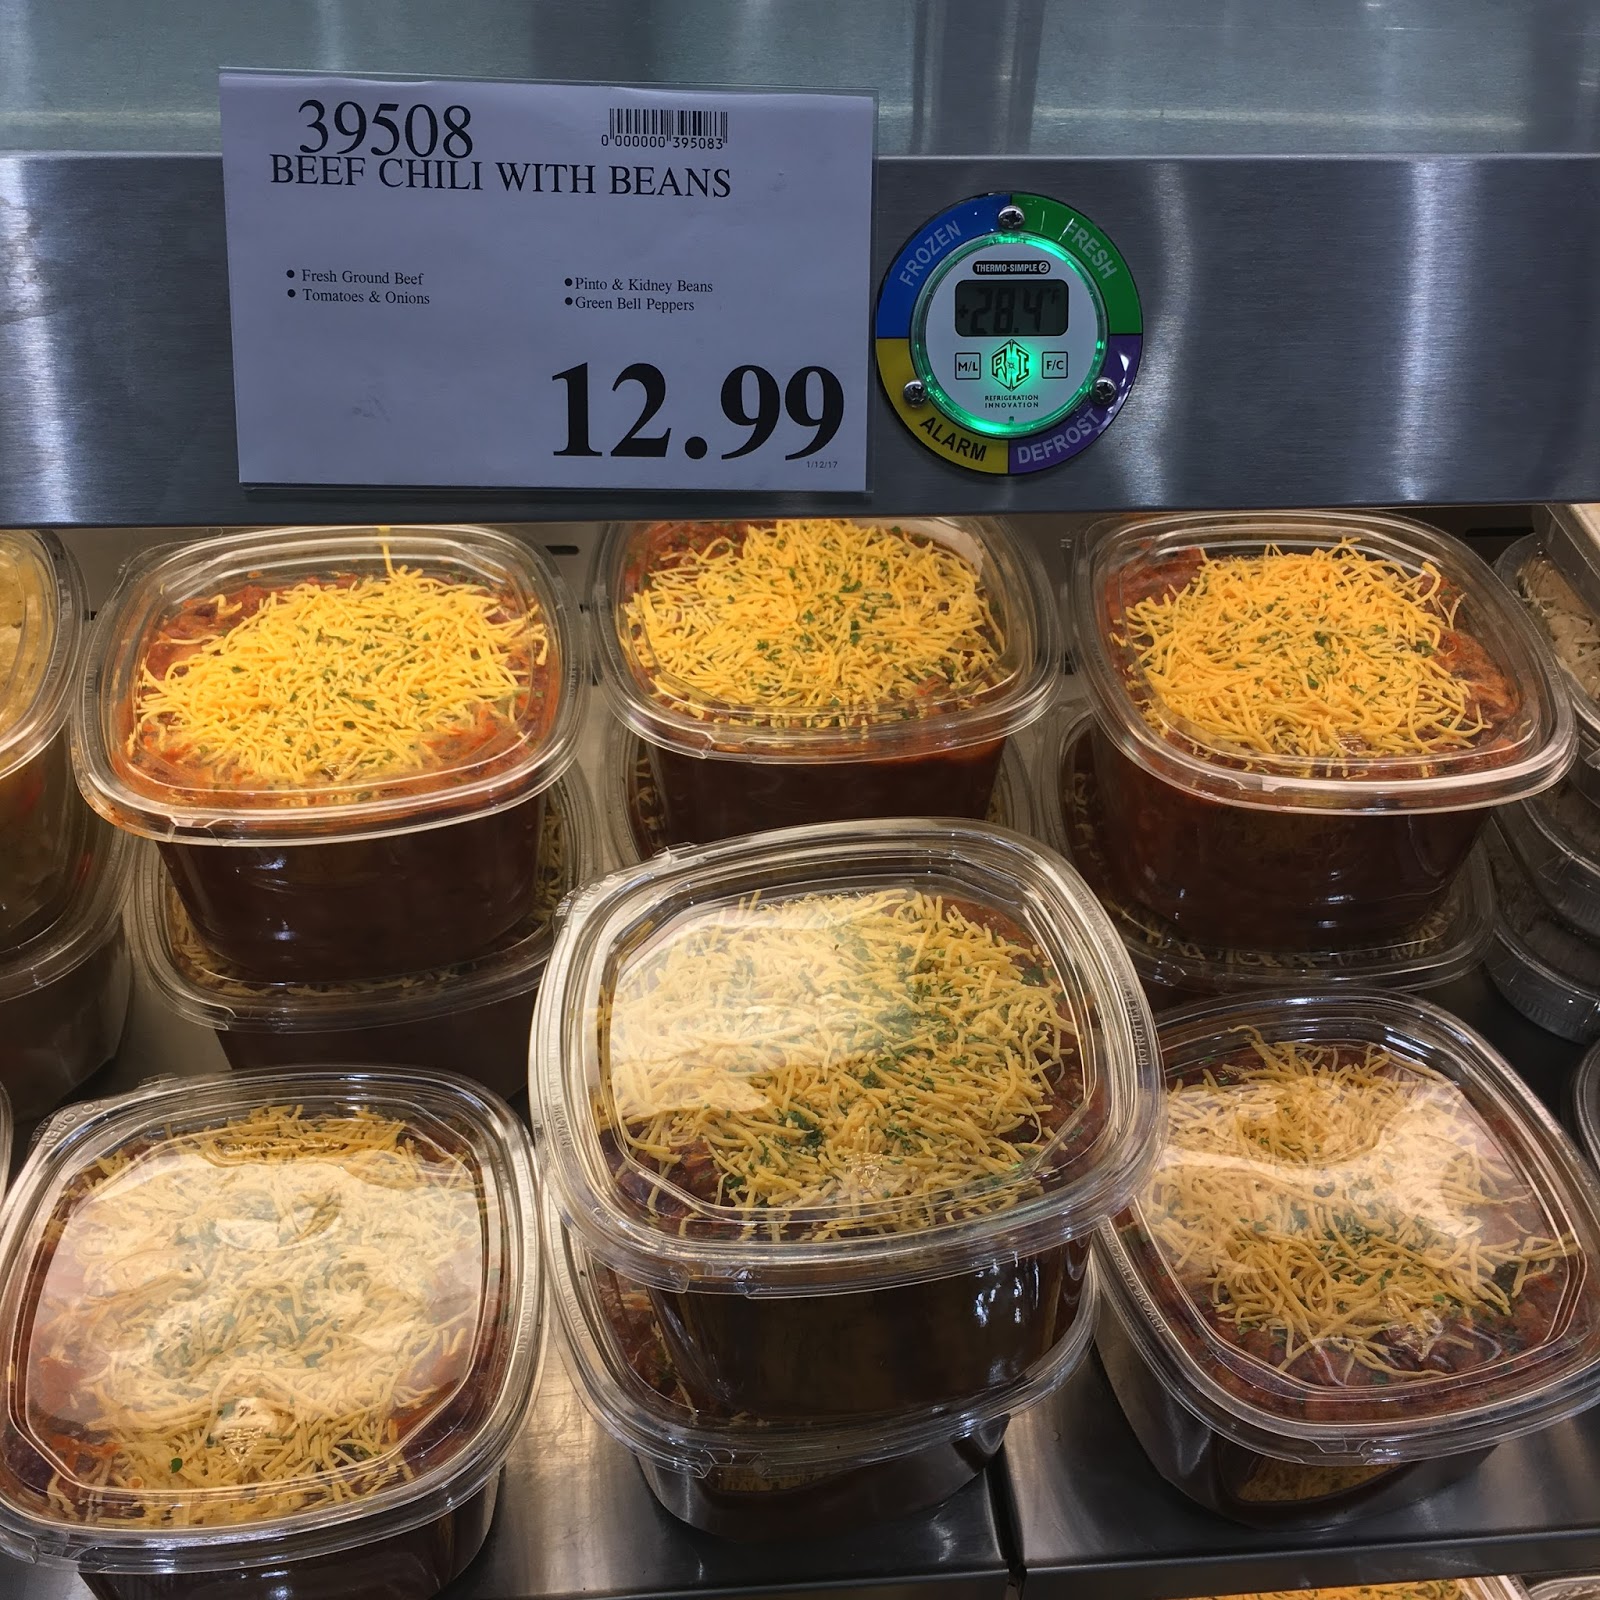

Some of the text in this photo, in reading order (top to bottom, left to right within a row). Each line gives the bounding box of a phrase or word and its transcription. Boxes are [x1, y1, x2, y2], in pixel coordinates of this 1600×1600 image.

[298, 99, 474, 159] 39508
[601, 134, 723, 150] 0 000000 395083
[269, 153, 731, 198] BEEF CHILI WITH BEANS
[899, 220, 962, 287] FROZEN
[1066, 218, 1118, 280] FRESH
[302, 269, 425, 286] Fresh Ground Beef
[575, 277, 713, 295] Pinto & Kidney Beans
[302, 288, 430, 305] Tomatoes & Onions
[575, 296, 695, 314] Green Bell Peppers
[958, 361, 979, 373] M/L
[1046, 360, 1065, 372] F/C
[984, 394, 1039, 402] REFRIGERATION
[551, 361, 845, 462] 12.99
[919, 415, 988, 463] ALARM
[1016, 408, 1101, 465] DEFROST
[806, 460, 838, 469] 1/12/17
